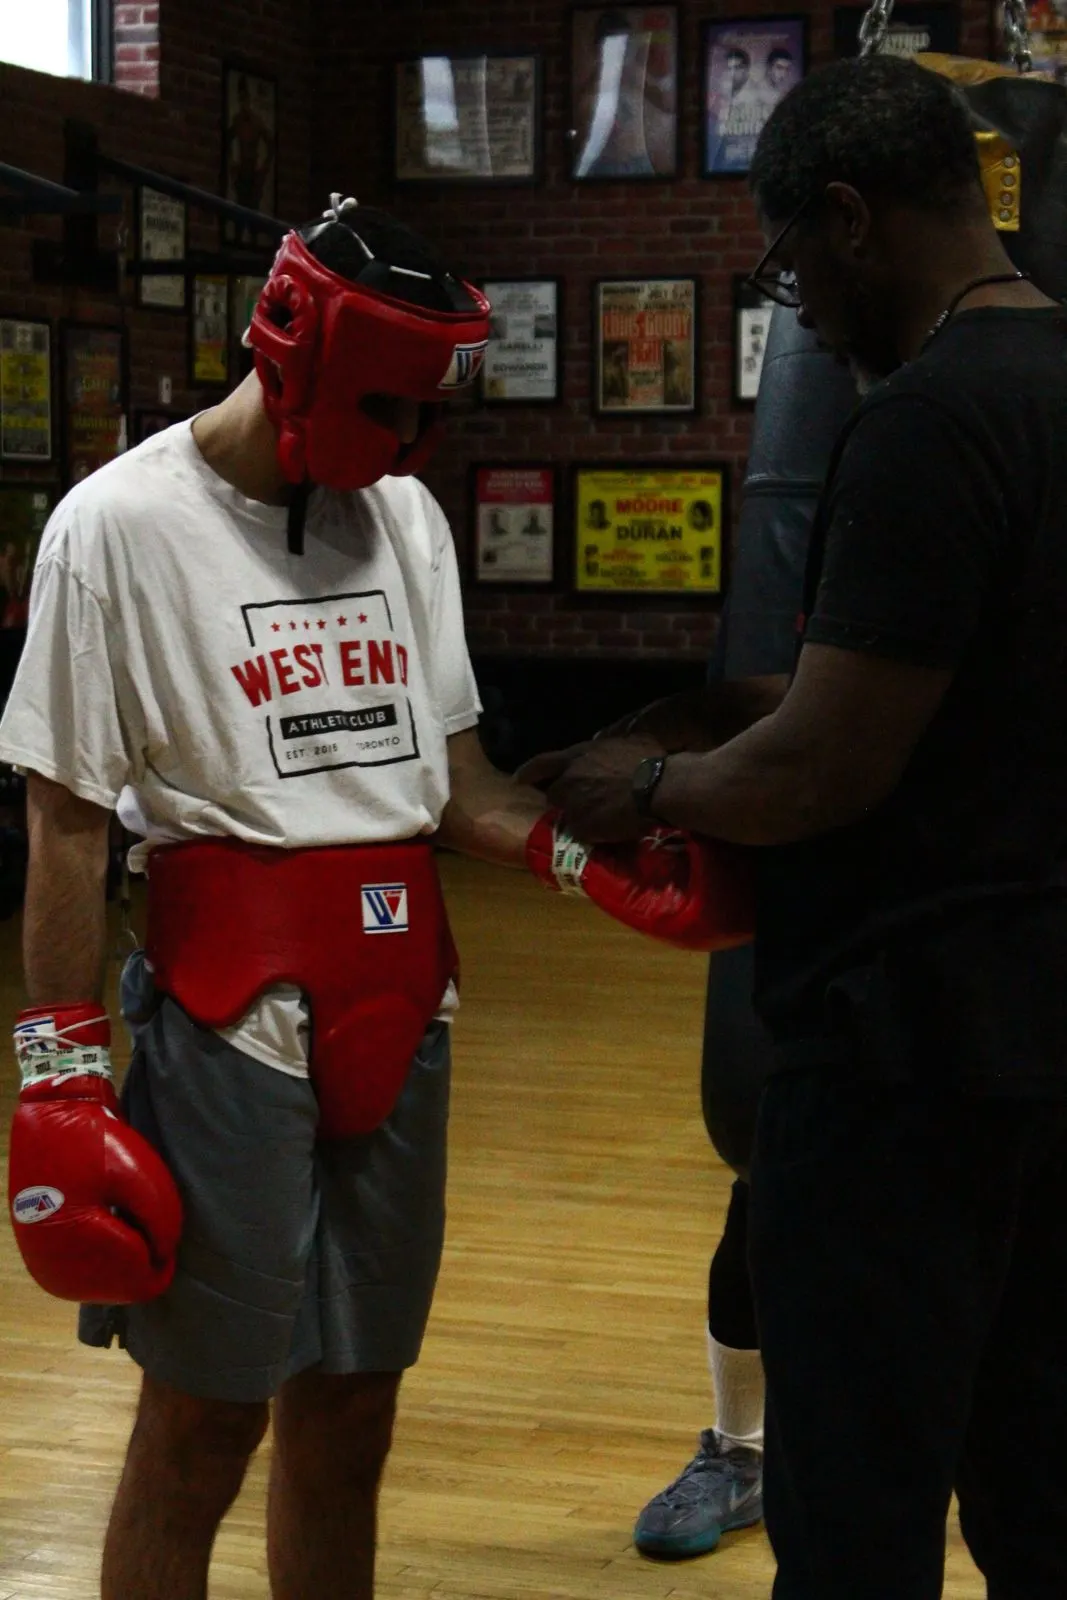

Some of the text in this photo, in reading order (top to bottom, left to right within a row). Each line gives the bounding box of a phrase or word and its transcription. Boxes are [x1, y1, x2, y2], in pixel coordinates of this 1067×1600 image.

[615, 497, 683, 514] MOORE
[616, 525, 683, 541] DURAN
[231, 640, 408, 706] WEST END
[349, 710, 387, 727] CLUB
